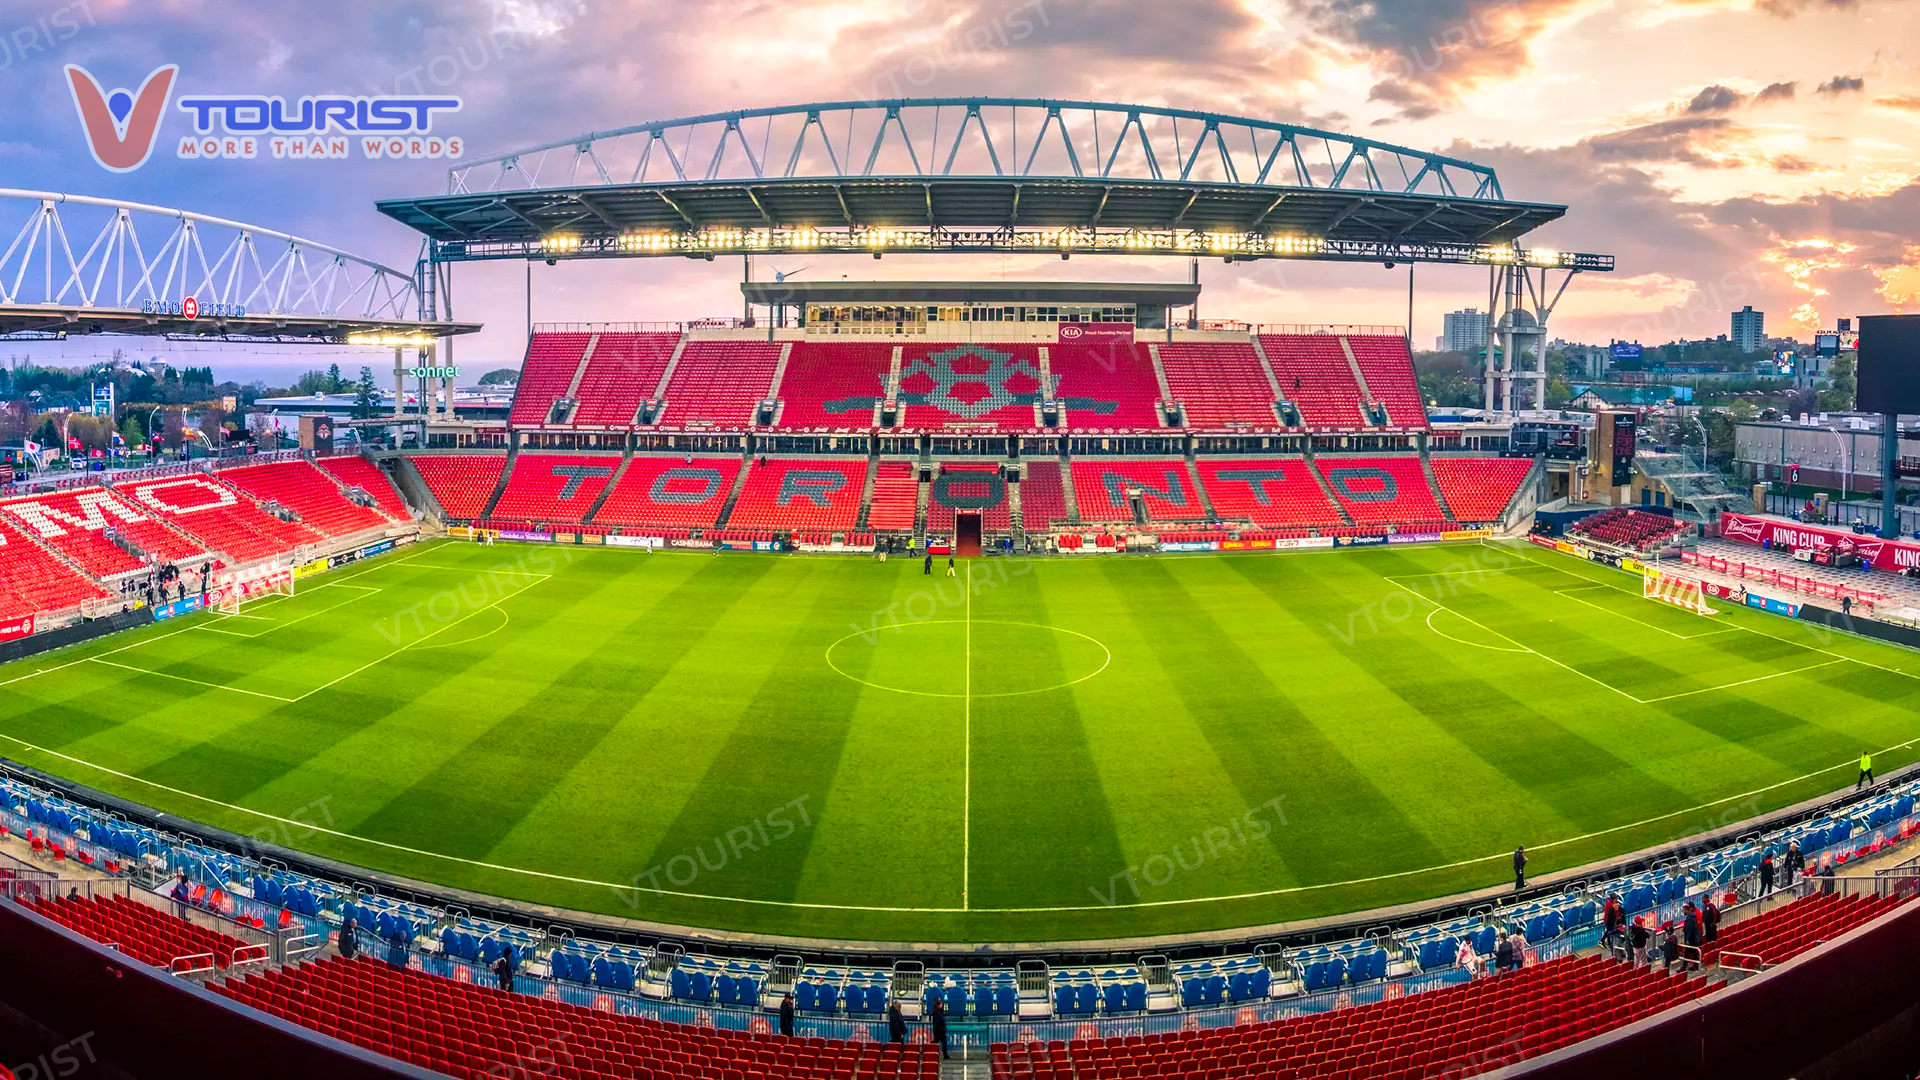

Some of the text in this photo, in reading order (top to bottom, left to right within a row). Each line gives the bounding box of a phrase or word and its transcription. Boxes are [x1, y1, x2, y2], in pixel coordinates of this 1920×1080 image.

[143, 299, 246, 317] BMO FIELD
[408, 366, 460, 378] sonnet
[1617, 427, 1633, 437] ALL
[1792, 469, 1798, 482] 6
[1727, 519, 1762, 537] Budweiser
[1773, 527, 1797, 546] KING
[695, 540, 713, 548] RAMA
